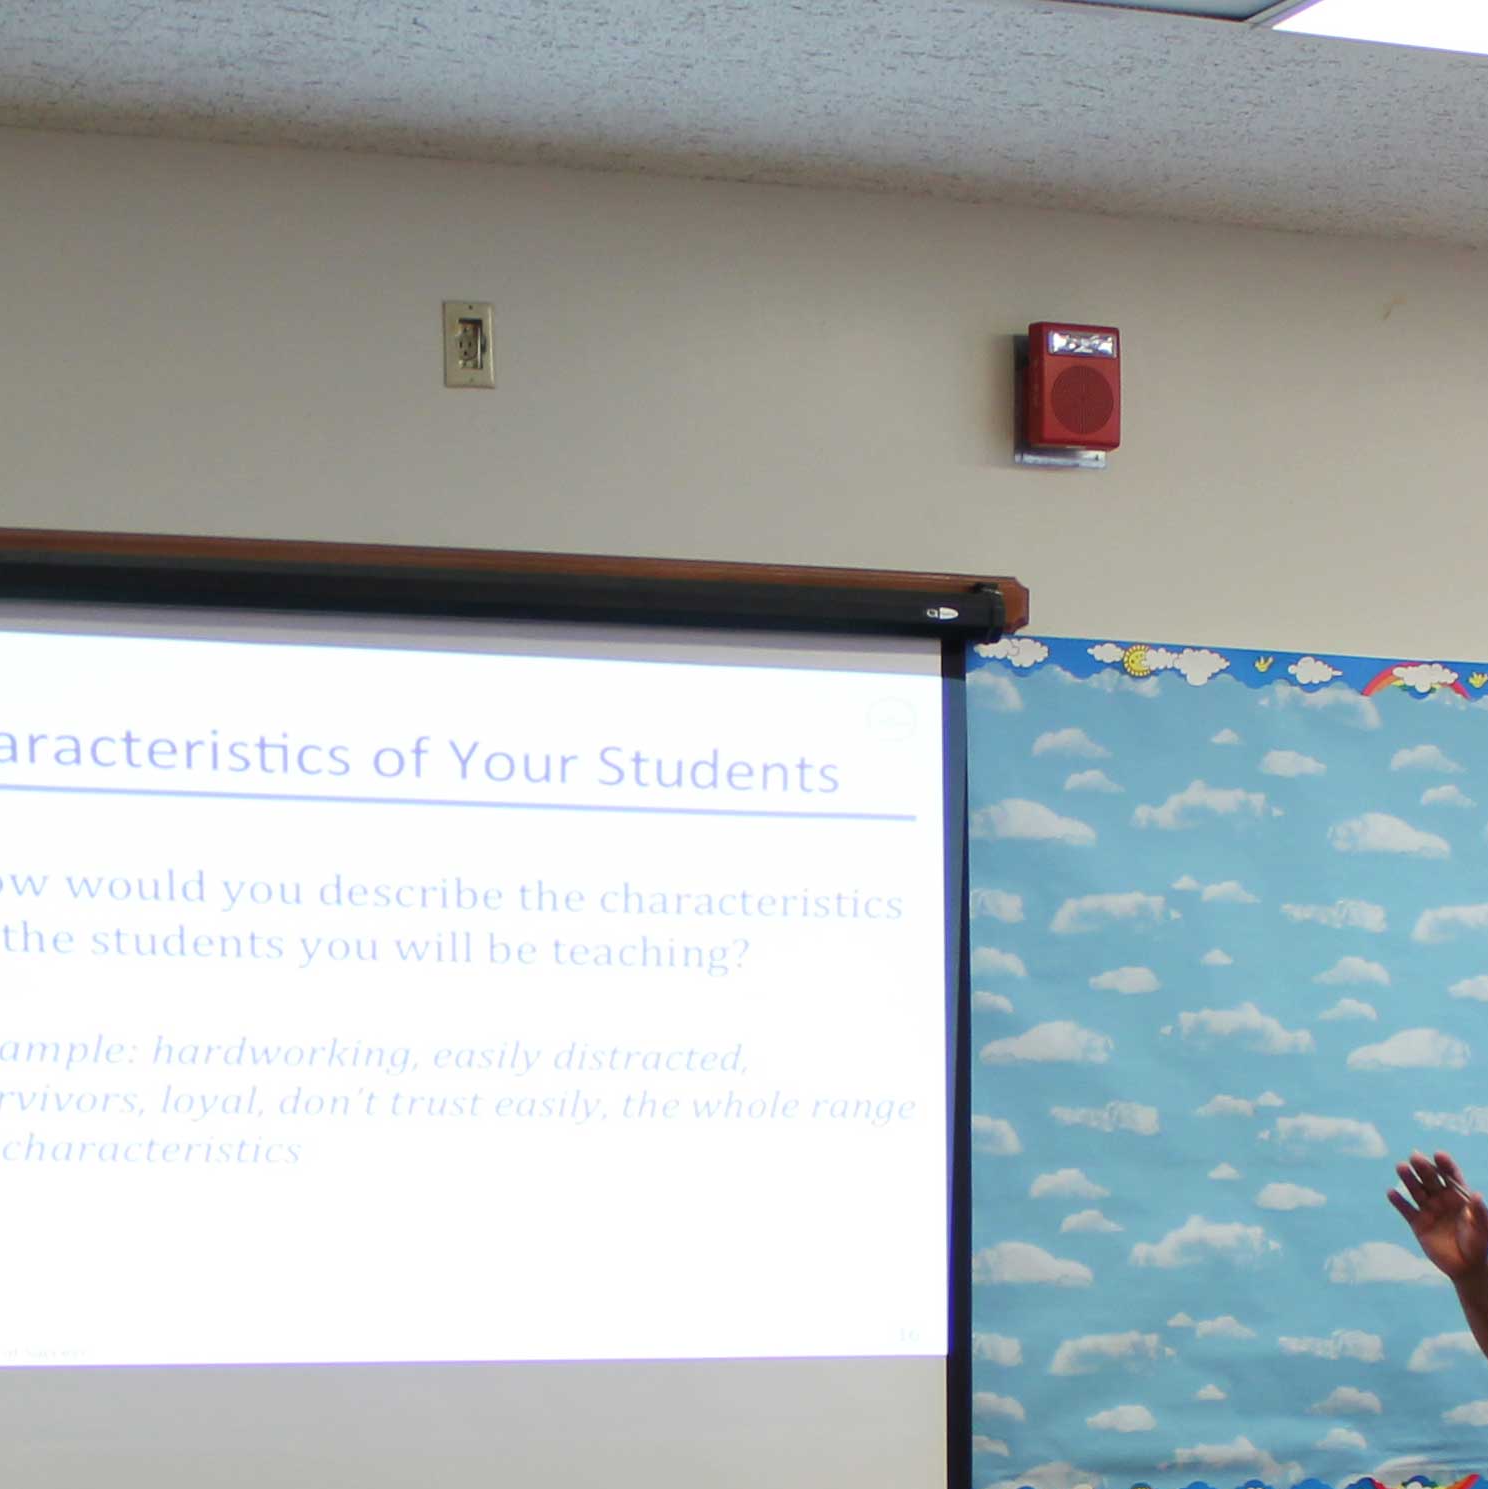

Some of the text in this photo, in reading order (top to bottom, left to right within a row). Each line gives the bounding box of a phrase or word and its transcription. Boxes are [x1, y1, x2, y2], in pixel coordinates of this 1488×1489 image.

[371, 735, 432, 779] of
[448, 738, 581, 785] Your
[596, 745, 841, 795] Students
[63, 866, 207, 904] would
[221, 879, 303, 913] you
[318, 871, 504, 911] describe
[518, 879, 586, 913] the
[599, 881, 904, 921] characteristics
[0, 918, 75, 957] the
[91, 924, 285, 960] students
[299, 936, 379, 969] you
[394, 929, 472, 964] will
[487, 930, 537, 968] be
[553, 935, 751, 977] teaching?
[152, 1035, 418, 1076] hardworking,
[433, 1040, 543, 1077] easily
[553, 1041, 747, 1074] distracted,
[160, 1084, 263, 1122] loyal,
[278, 1086, 380, 1119] don't
[390, 1090, 482, 1119] trust
[494, 1088, 607, 1125] easily,
[622, 1089, 680, 1120] the
[693, 1090, 800, 1119] whole
[812, 1098, 916, 1126] range
[0, 1131, 302, 1166] characteristics
